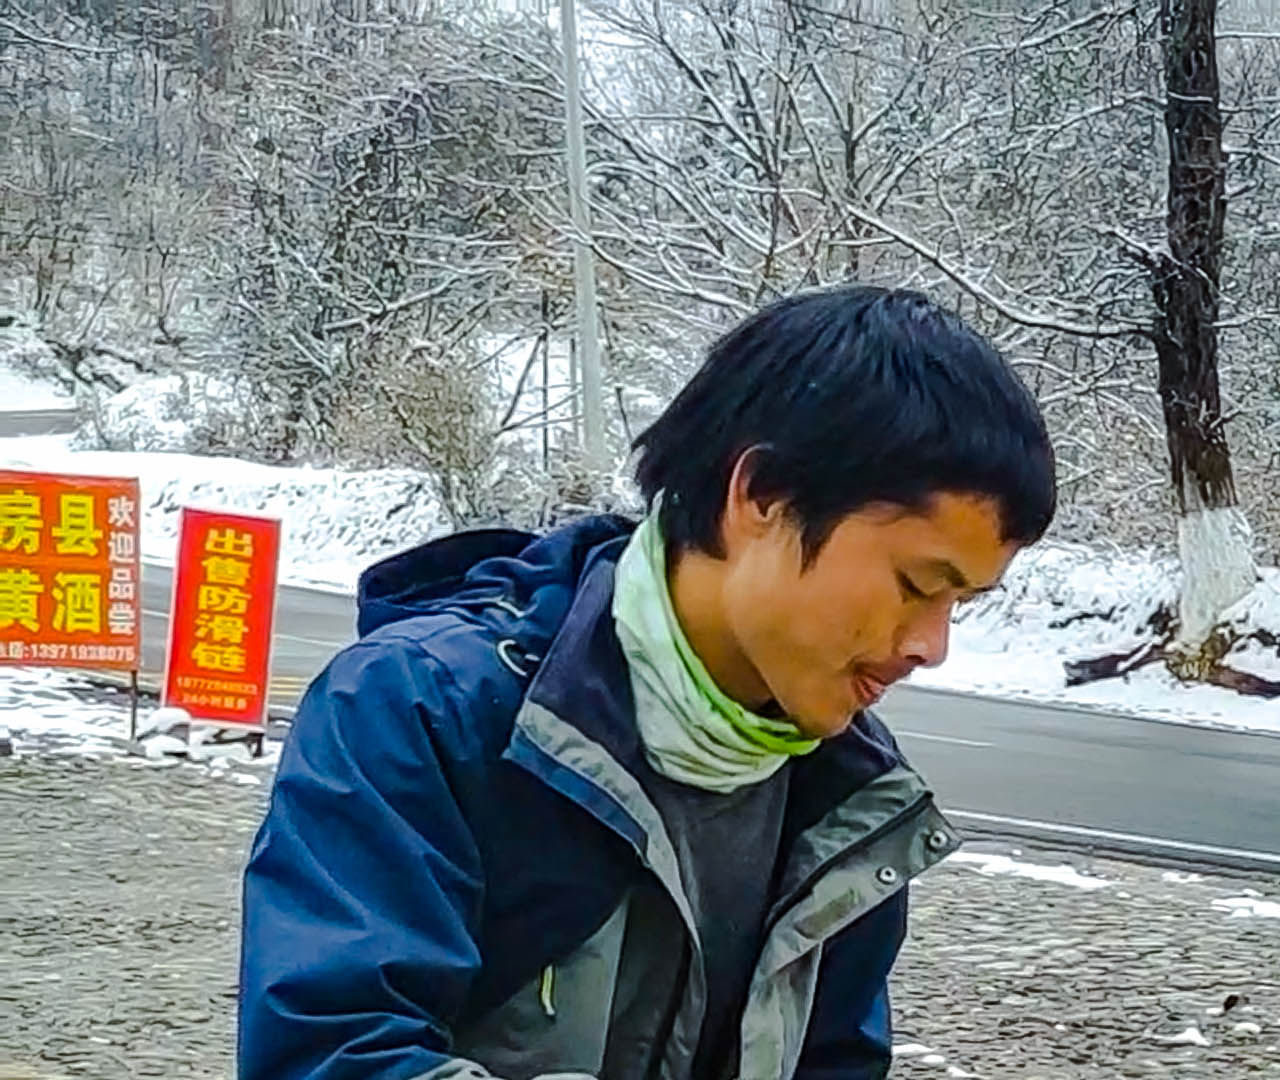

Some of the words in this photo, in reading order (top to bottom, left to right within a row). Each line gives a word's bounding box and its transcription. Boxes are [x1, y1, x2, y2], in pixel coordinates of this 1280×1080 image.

[0, 489, 103, 557] 房县
[108, 495, 136, 635] 欢迎品尝
[0, 568, 101, 633] 黄酒
[191, 527, 253, 673] 出售防滑链
